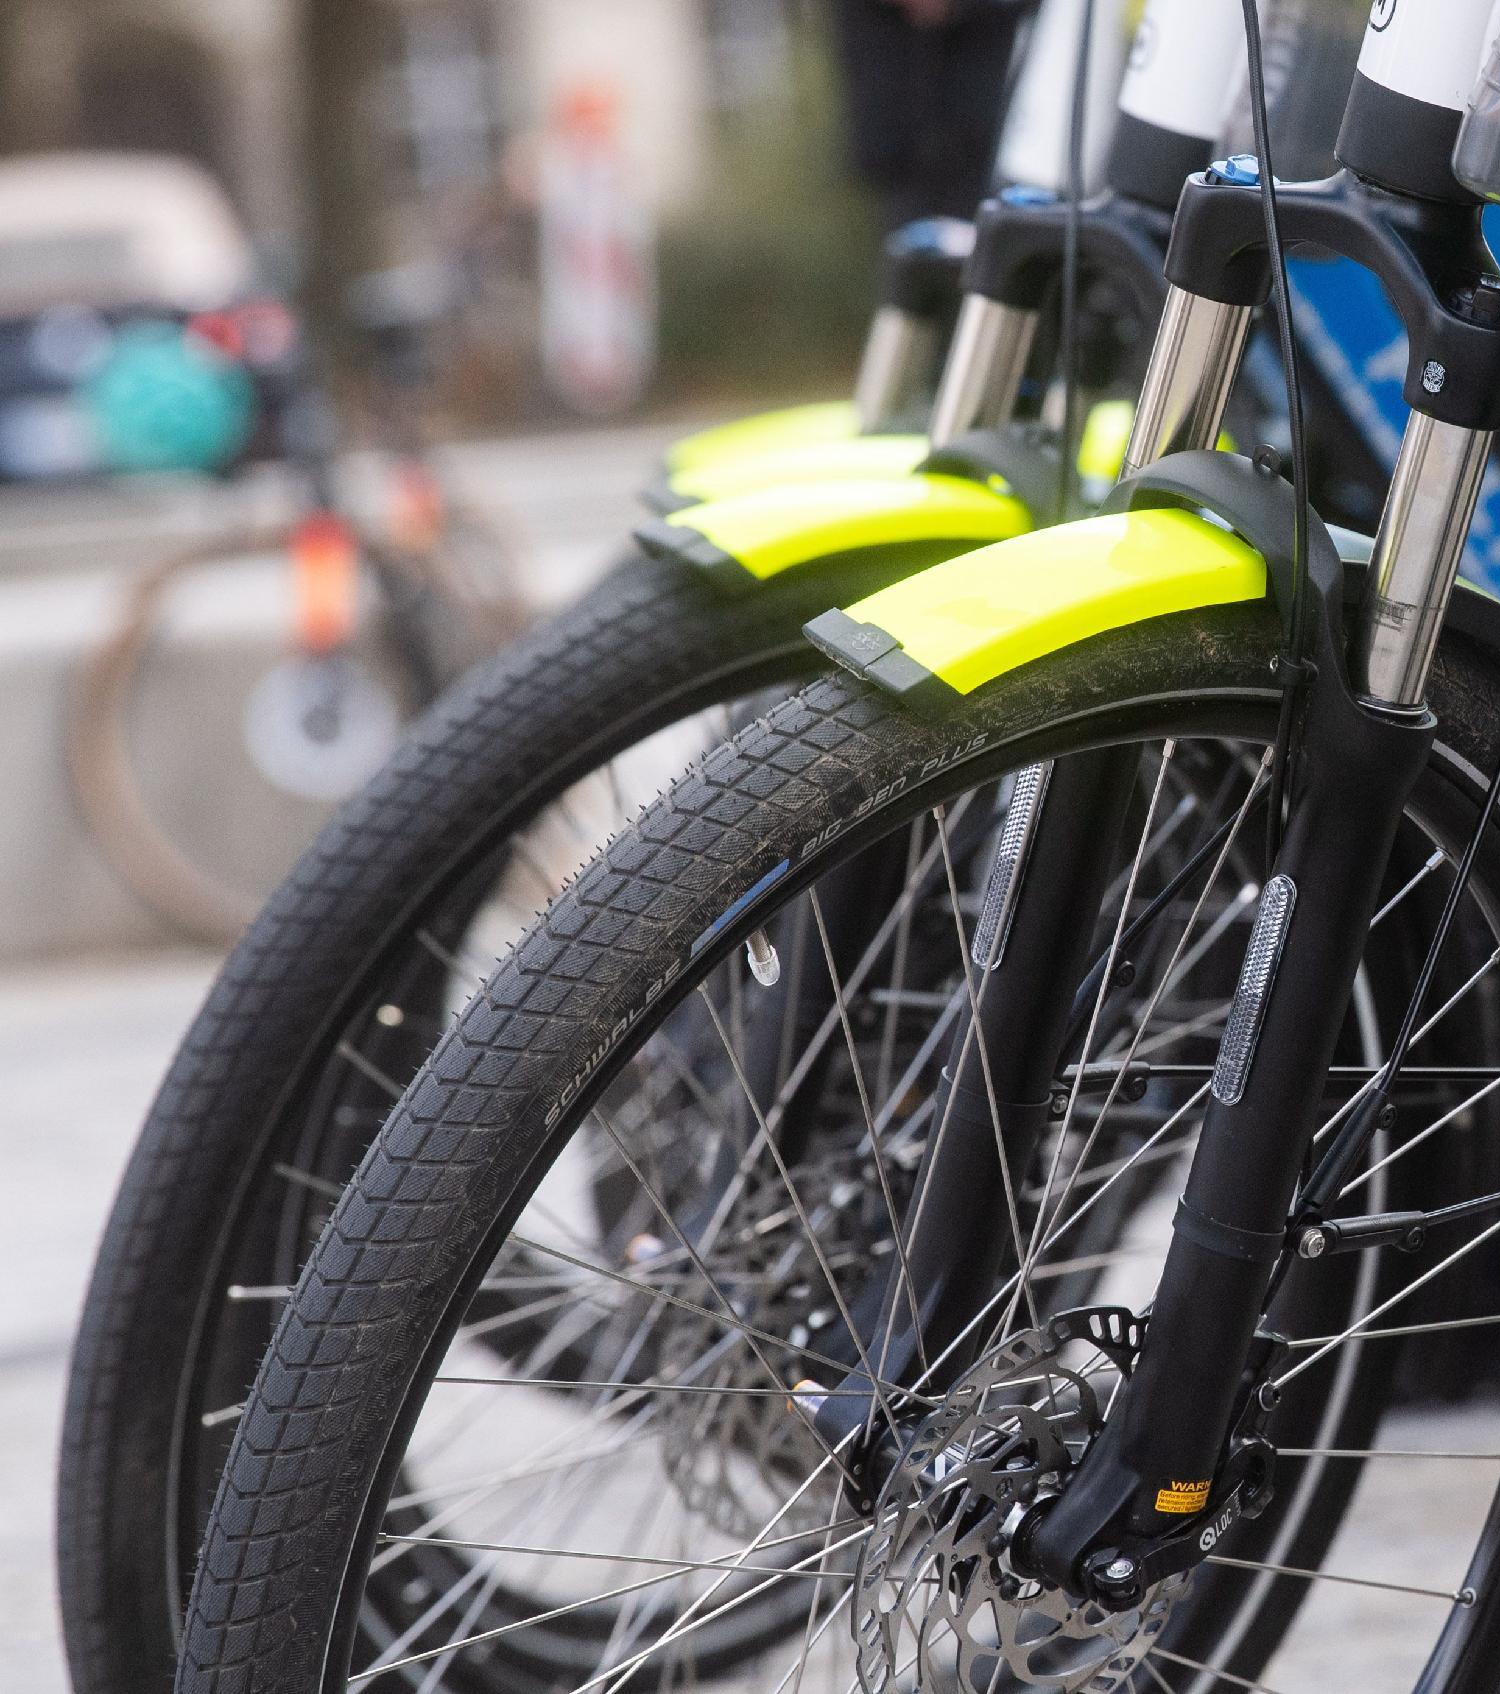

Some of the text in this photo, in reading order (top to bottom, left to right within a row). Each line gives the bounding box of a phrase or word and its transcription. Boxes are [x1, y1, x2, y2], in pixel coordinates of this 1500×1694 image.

[801, 818, 843, 859] BIG
[921, 732, 989, 778] PLUS
[545, 958, 681, 1131] SCHWALBE
